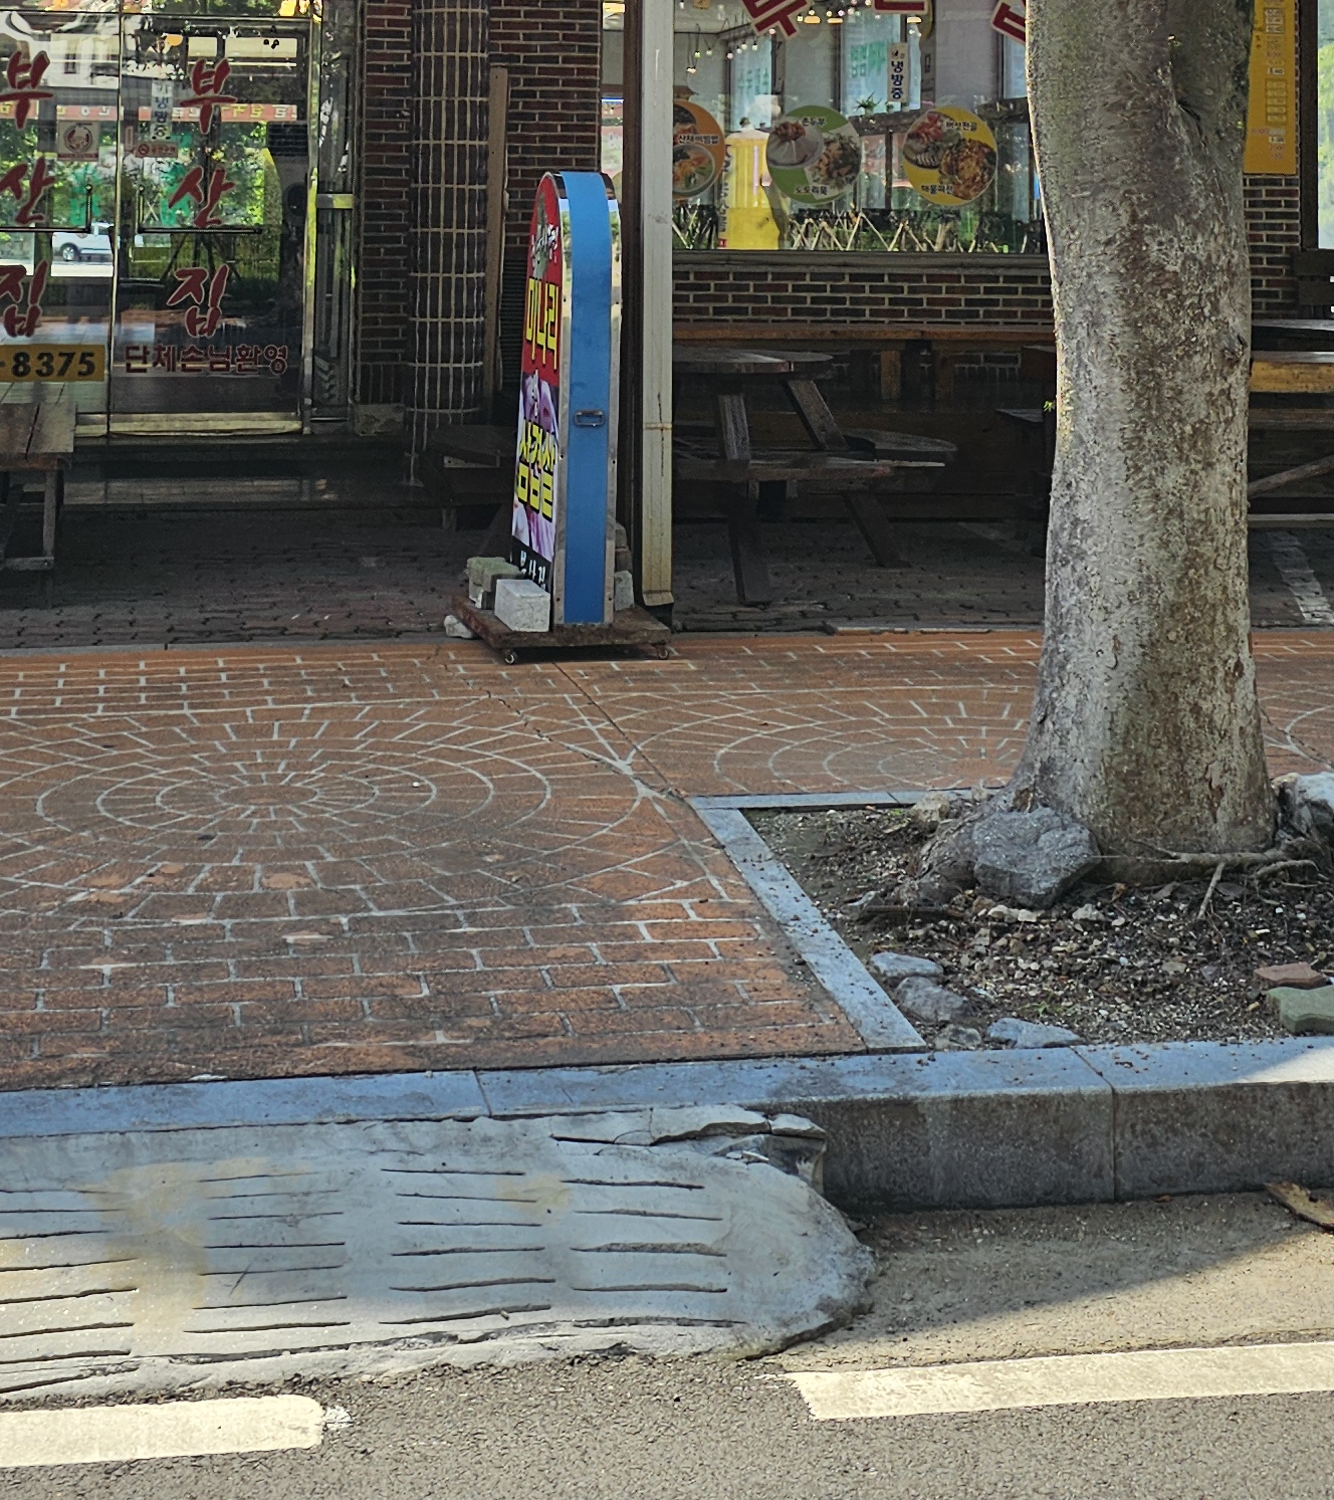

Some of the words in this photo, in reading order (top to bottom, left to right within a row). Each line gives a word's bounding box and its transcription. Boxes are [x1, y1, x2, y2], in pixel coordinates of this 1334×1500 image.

[167, 56, 239, 338] 부산집
[124, 343, 289, 376] 단체손님환영
[525, 276, 559, 371] 미나리
